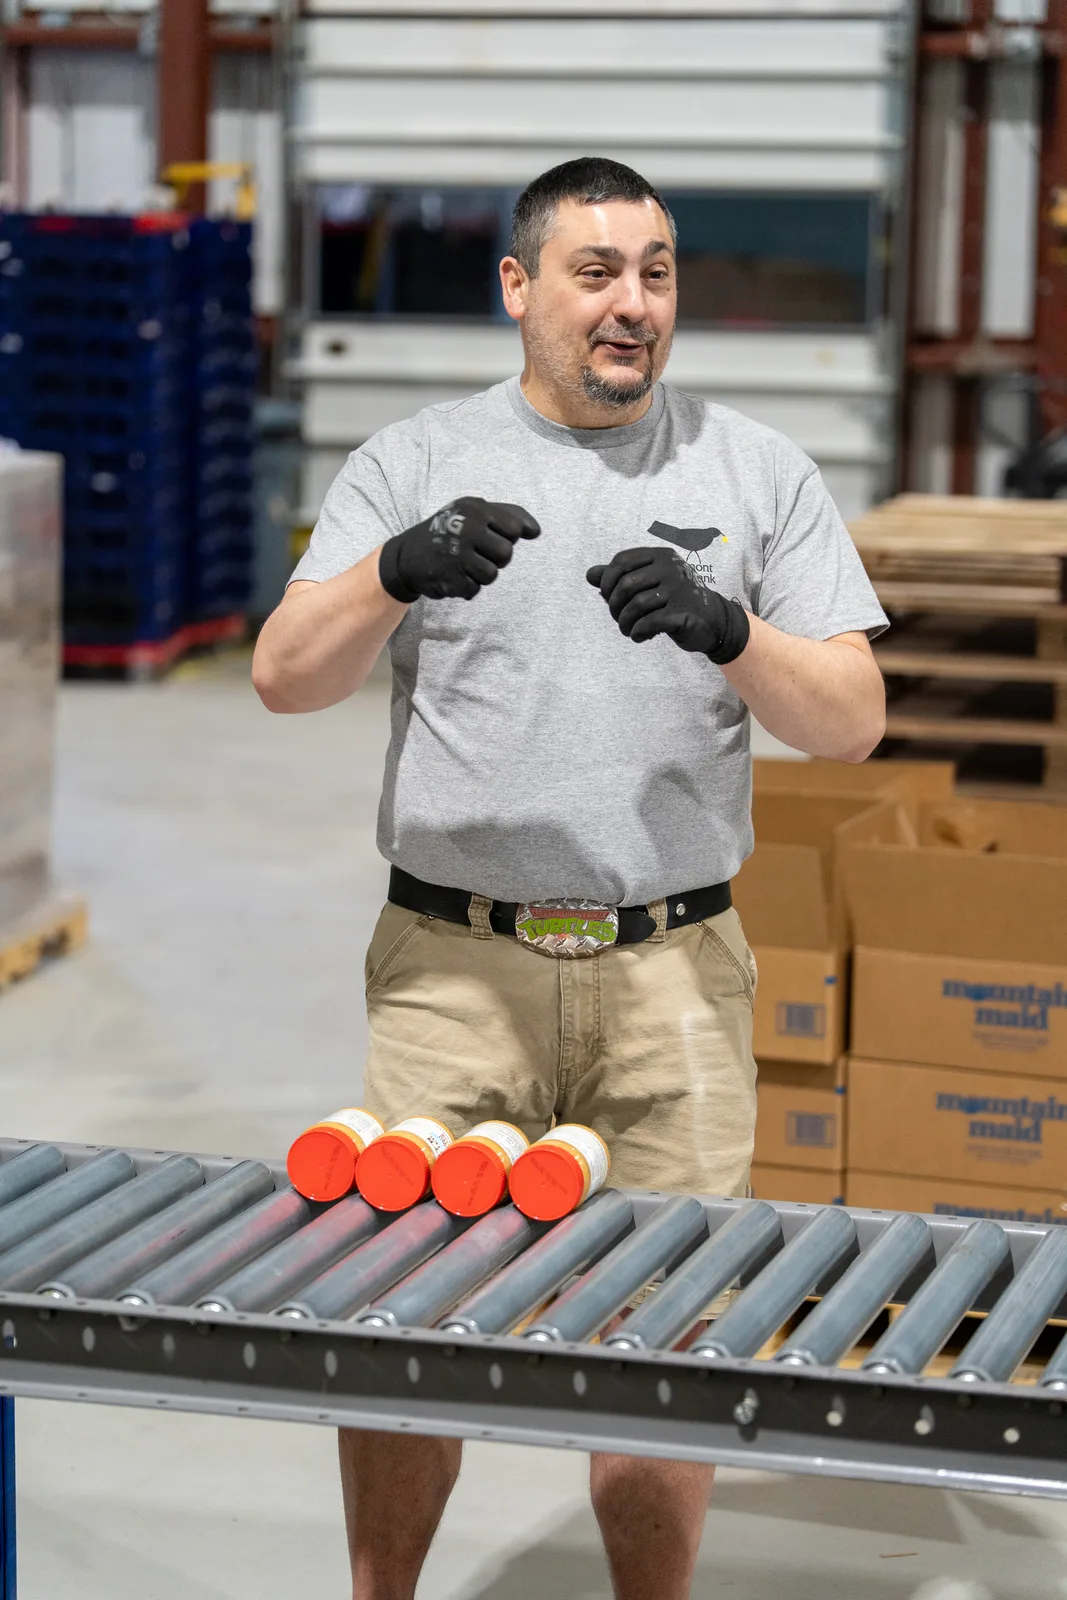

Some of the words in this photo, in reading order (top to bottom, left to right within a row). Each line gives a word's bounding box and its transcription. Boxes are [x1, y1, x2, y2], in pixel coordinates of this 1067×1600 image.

[517, 917, 617, 943] TURTLES
[976, 1003, 1048, 1030] maid
[968, 1117, 1042, 1143] maid
